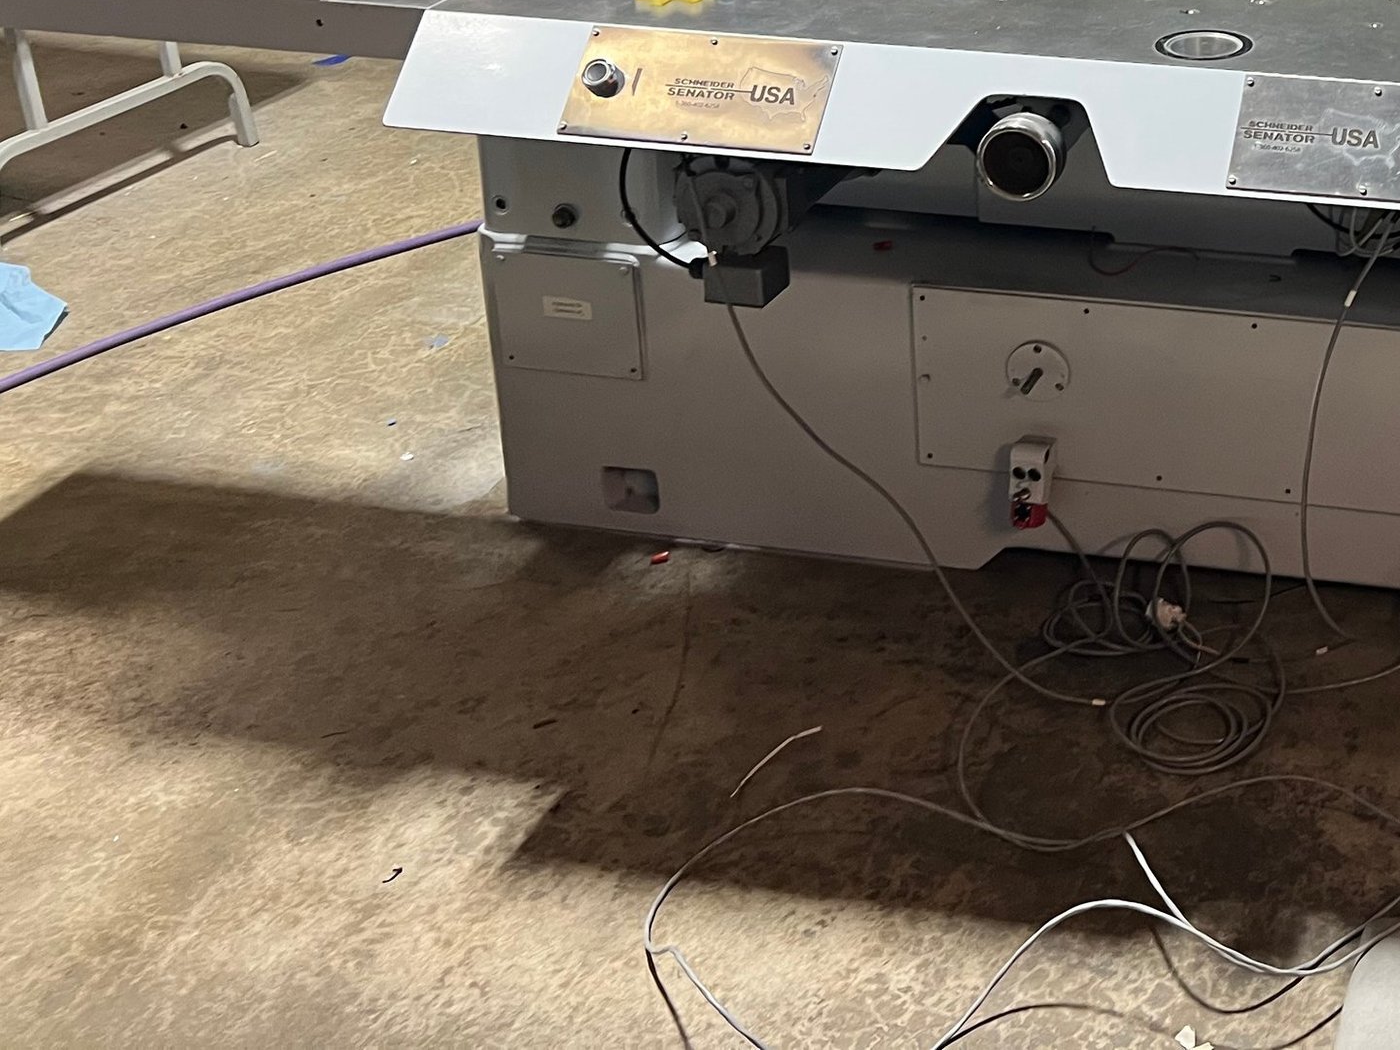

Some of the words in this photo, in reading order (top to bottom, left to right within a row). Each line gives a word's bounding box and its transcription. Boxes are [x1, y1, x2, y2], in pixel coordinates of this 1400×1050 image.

[674, 77, 735, 89] SCHNEIDER
[666, 87, 735, 101] SENATOR
[749, 84, 795, 106] USA
[1248, 120, 1313, 132] SCHNEIDER
[1242, 130, 1316, 144] SENATOR
[1330, 126, 1379, 149] USA
